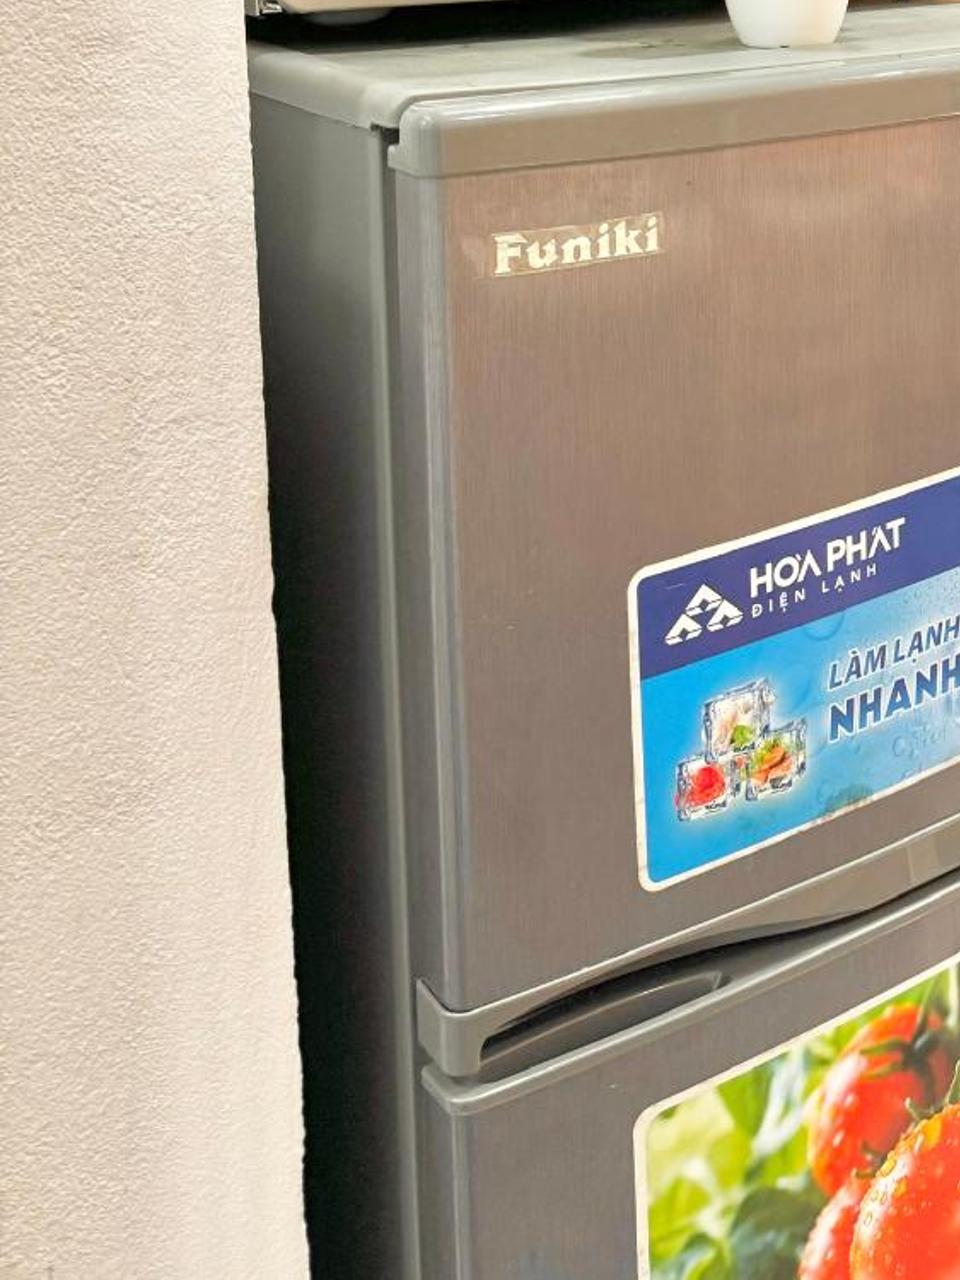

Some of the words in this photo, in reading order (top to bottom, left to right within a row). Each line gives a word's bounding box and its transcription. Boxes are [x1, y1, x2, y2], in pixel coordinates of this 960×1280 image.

[494, 216, 658, 275] Funiki
[827, 517, 906, 572] PHÁT
[821, 563, 877, 594] LẠNH
[829, 649, 887, 690] LÀM
[893, 614, 960, 663] LẠNH
